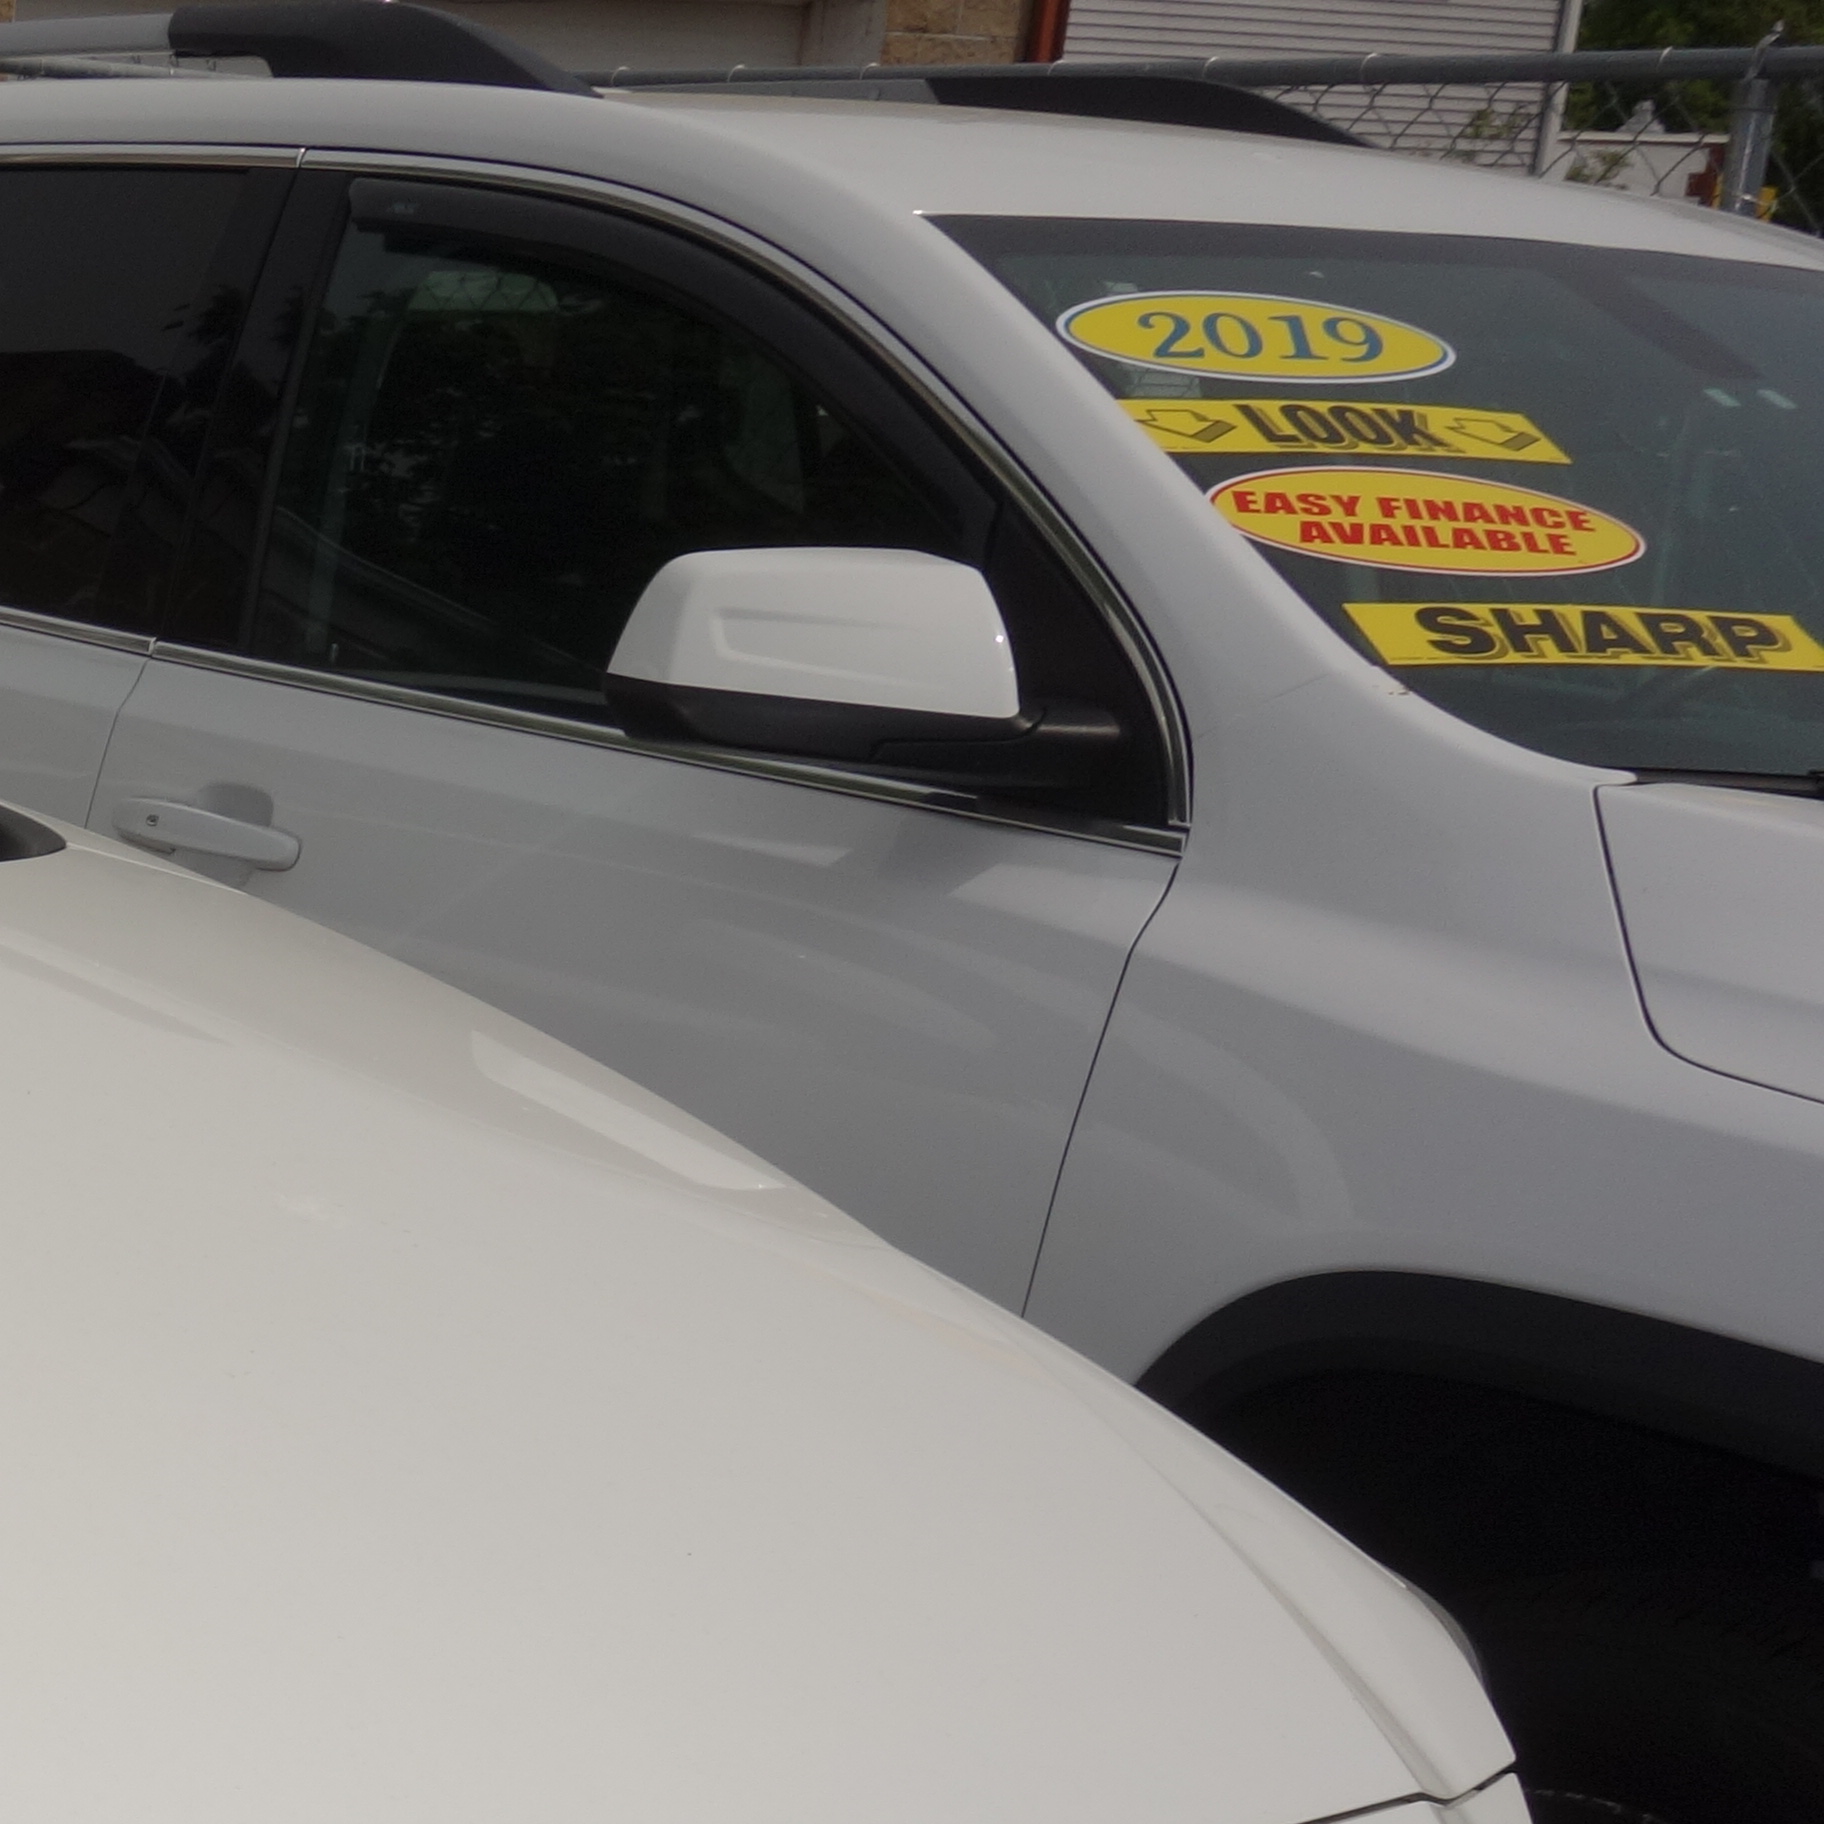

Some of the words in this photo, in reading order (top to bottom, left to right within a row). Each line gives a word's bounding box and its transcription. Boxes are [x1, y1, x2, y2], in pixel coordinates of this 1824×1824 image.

[1136, 311, 1385, 363] 2019
[1233, 404, 1458, 451] LOOK
[1232, 490, 1361, 517] EASY
[1378, 496, 1596, 533] FINANCE
[1299, 520, 1576, 556] AVAILABLE
[1414, 606, 1786, 660] SHARP
